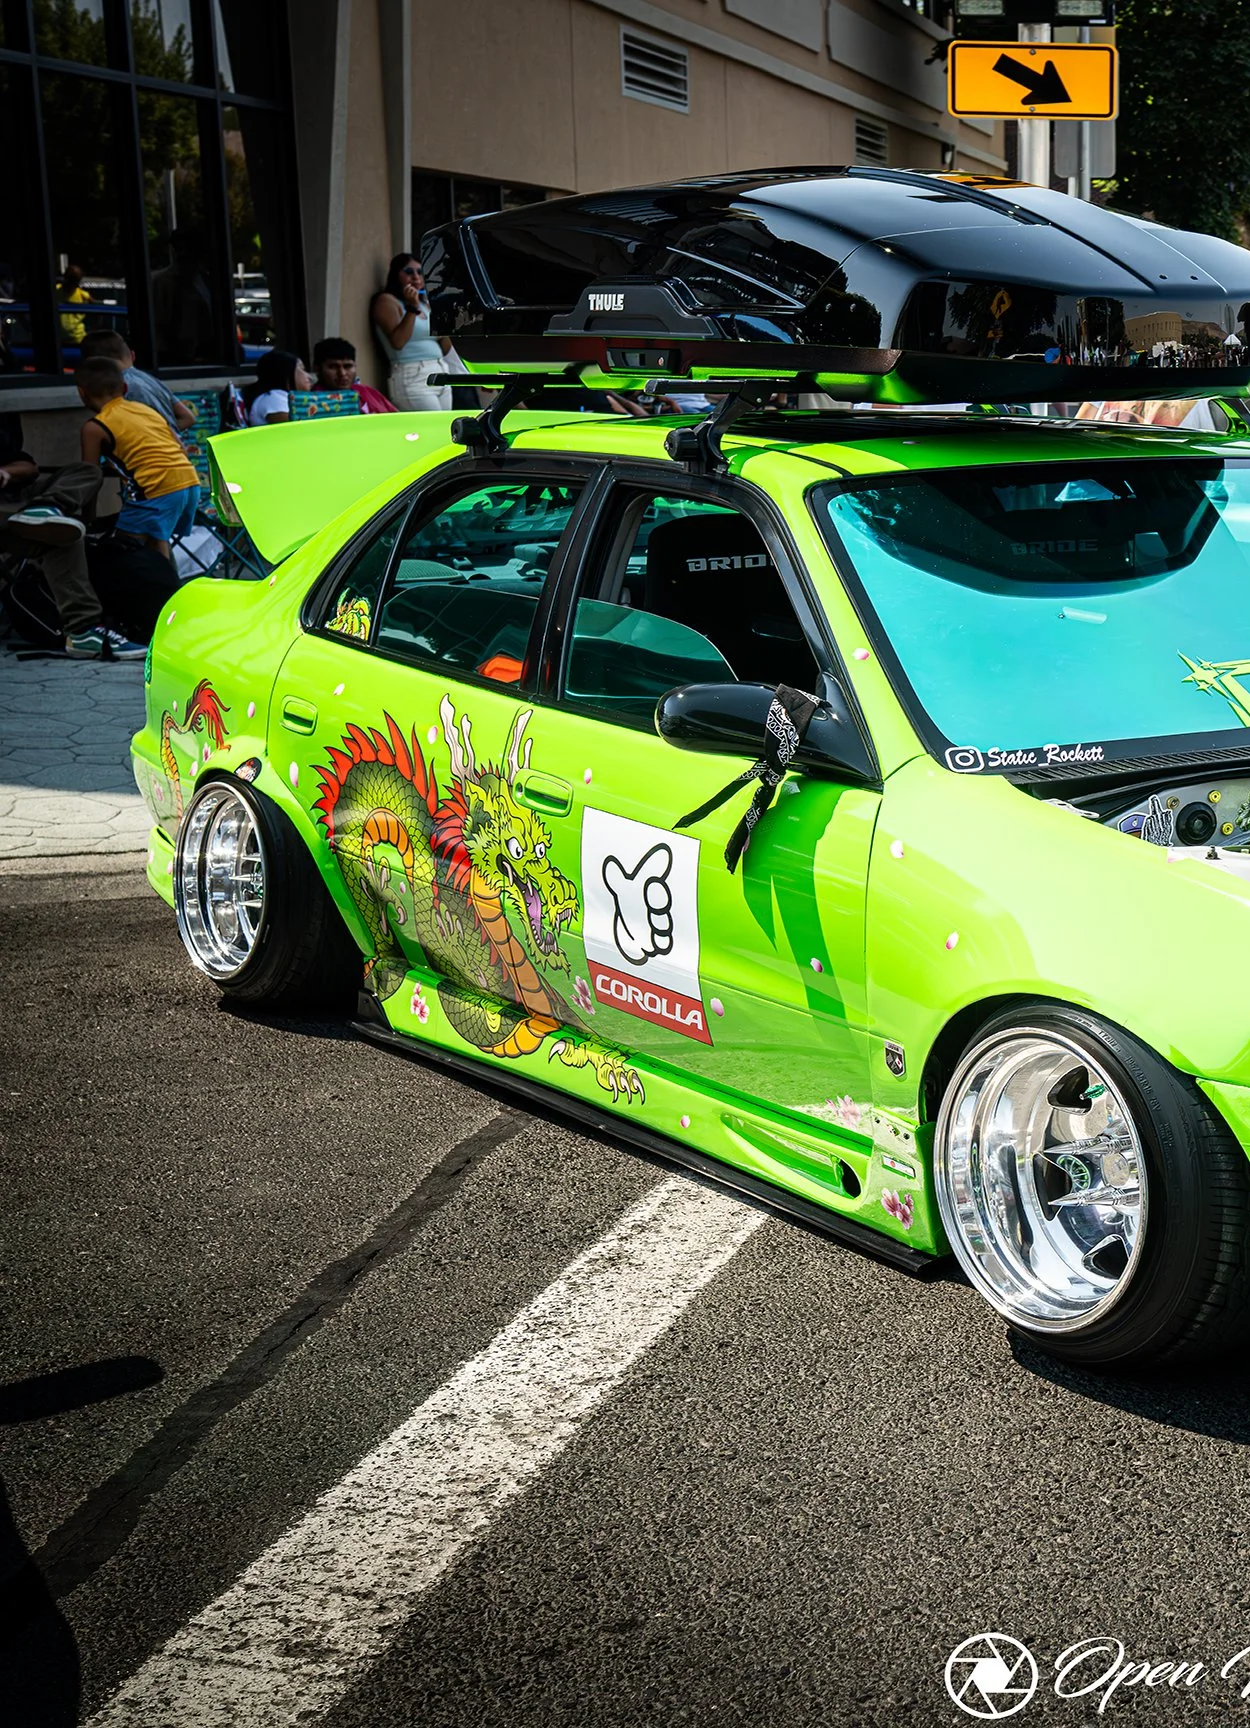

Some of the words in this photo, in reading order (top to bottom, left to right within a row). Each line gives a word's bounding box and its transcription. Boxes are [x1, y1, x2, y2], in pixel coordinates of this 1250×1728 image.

[588, 293, 625, 312] THULE
[1010, 539, 1099, 556] BRIDE
[686, 554, 775, 572] BRID
[595, 973, 704, 1031] COROLLA
